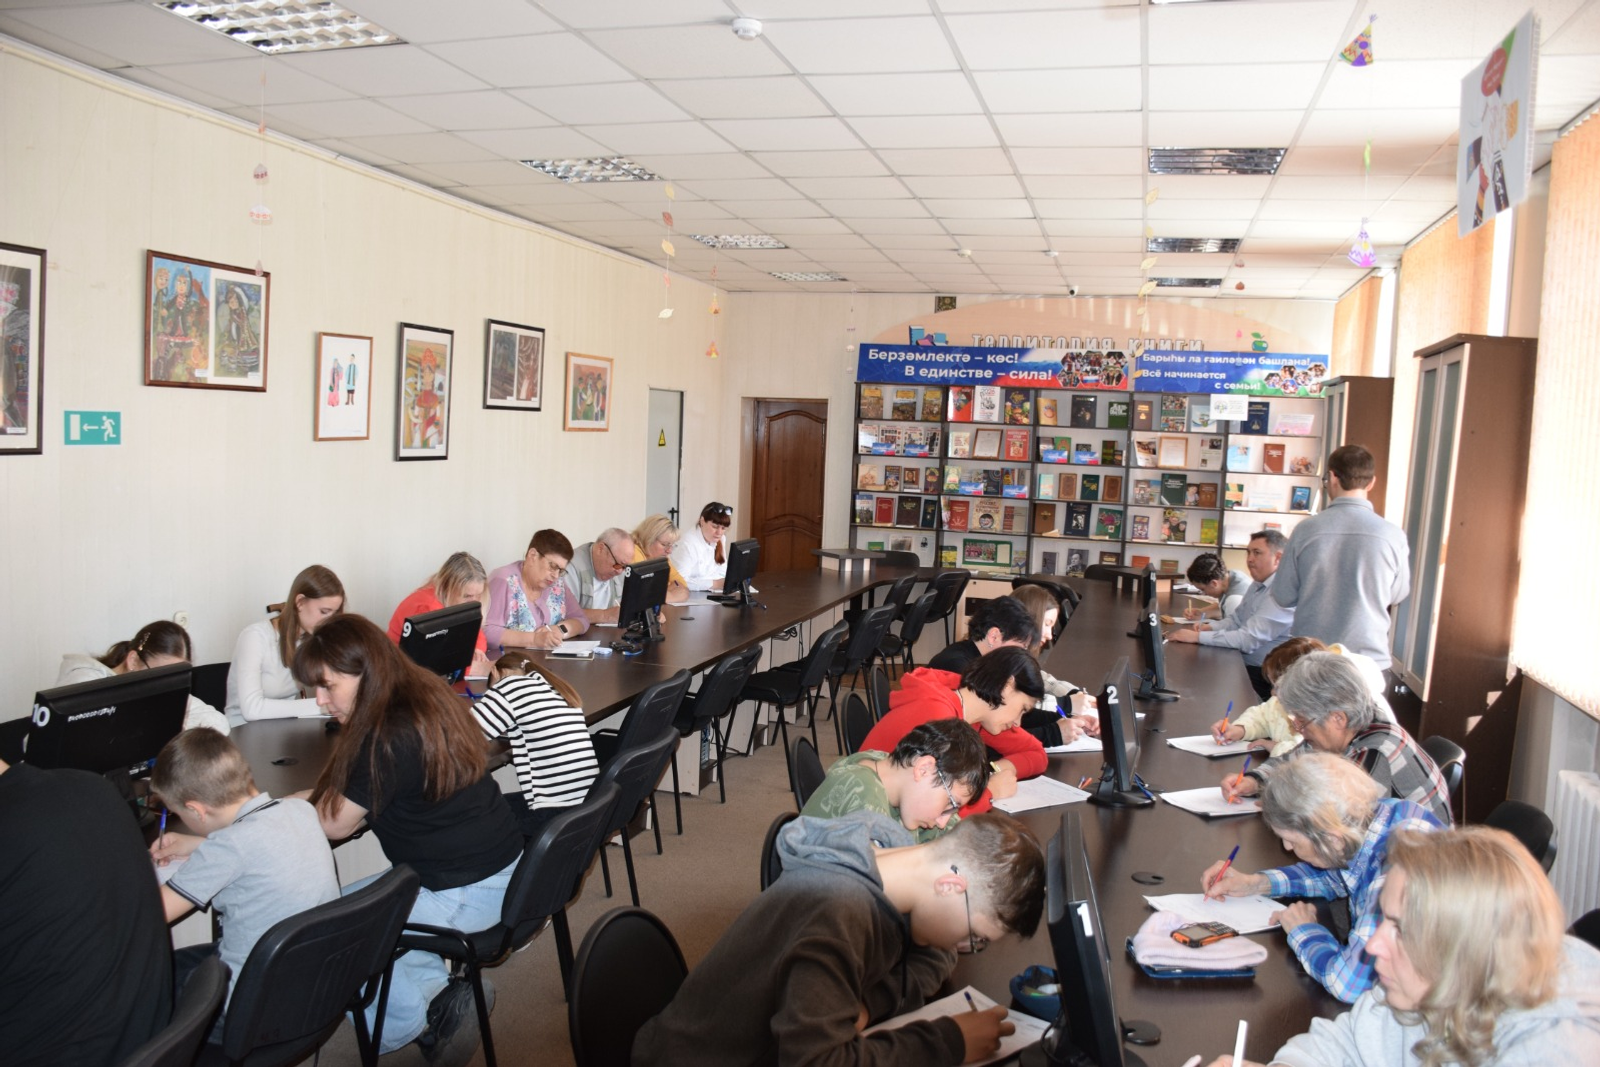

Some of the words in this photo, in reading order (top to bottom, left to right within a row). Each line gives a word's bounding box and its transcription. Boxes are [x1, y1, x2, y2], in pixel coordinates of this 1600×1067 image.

[987, 352, 1019, 364] көс!
[1143, 354, 1186, 364] Барыһы
[1188, 356, 1201, 364] ла
[1259, 356, 1311, 367] башлана!
[904, 365, 915, 376] В
[919, 367, 993, 380] единстве
[1009, 369, 1052, 380] сила!
[1142, 369, 1161, 379] Всё
[1164, 371, 1226, 380] начинается
[1224, 382, 1261, 391] семьи!
[625, 566, 632, 578] 8
[1150, 571, 1156, 582] 4
[1149, 612, 1158, 627] 3
[402, 621, 412, 638] 9
[1106, 685, 1119, 705] 2
[32, 703, 51, 727] 10
[1076, 902, 1094, 938] 1
